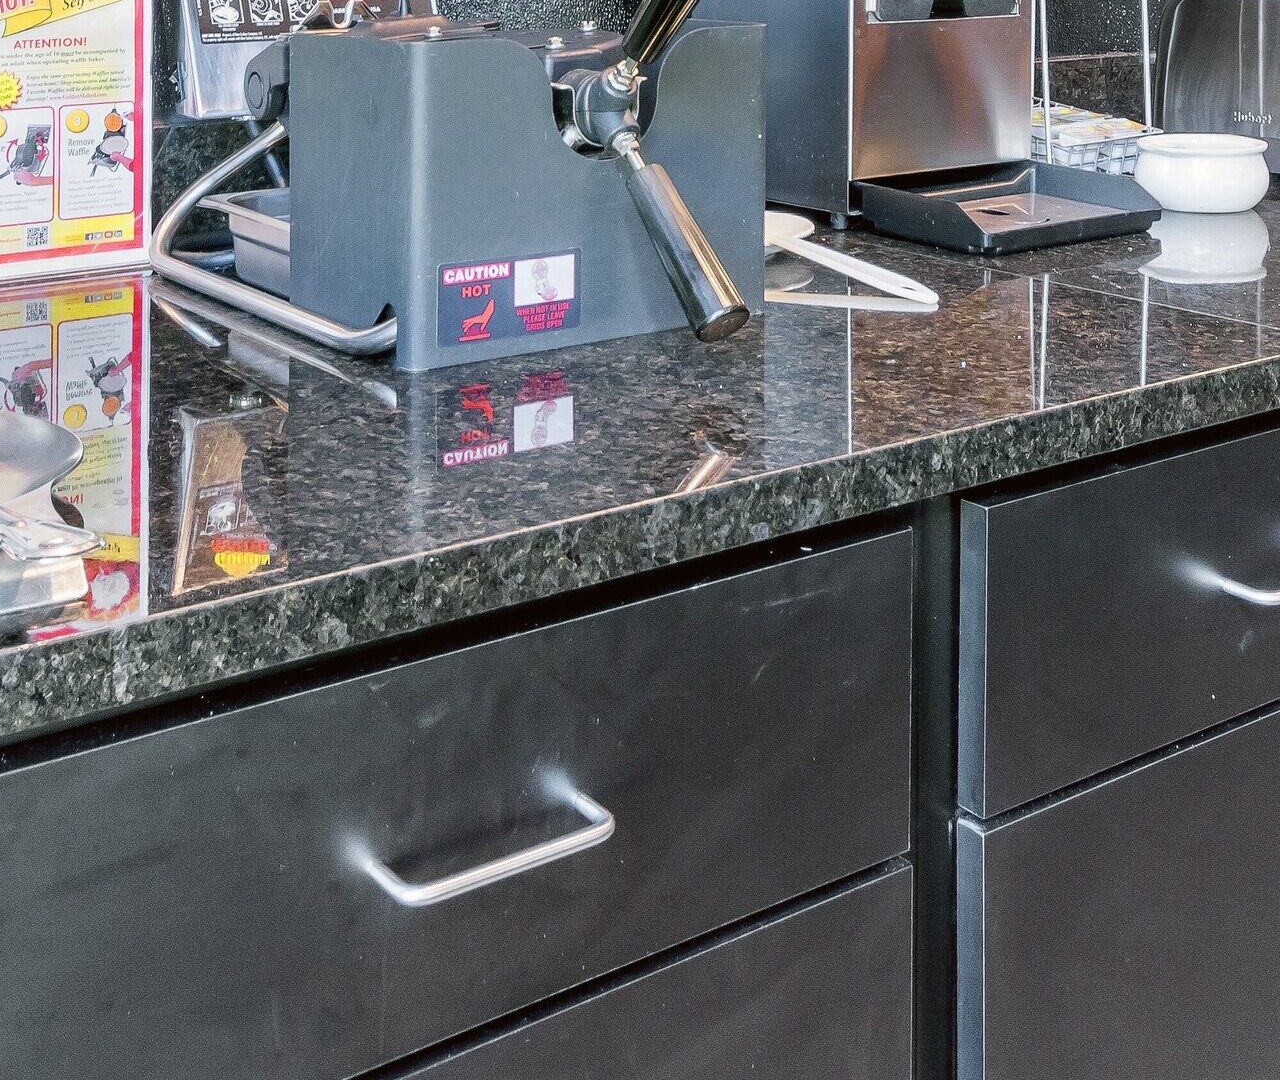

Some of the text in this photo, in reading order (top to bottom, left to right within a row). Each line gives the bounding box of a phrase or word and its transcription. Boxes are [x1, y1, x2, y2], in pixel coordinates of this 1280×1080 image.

[13, 37, 87, 50] ATTENTION!
[68, 138, 95, 147] Remove
[68, 148, 90, 157] Waffle
[444, 263, 509, 283] CAUTION
[462, 284, 492, 299] HOT
[516, 307, 535, 316] WHEN
[536, 304, 549, 313] NOT
[523, 311, 564, 323] PLEASE LEAVE
